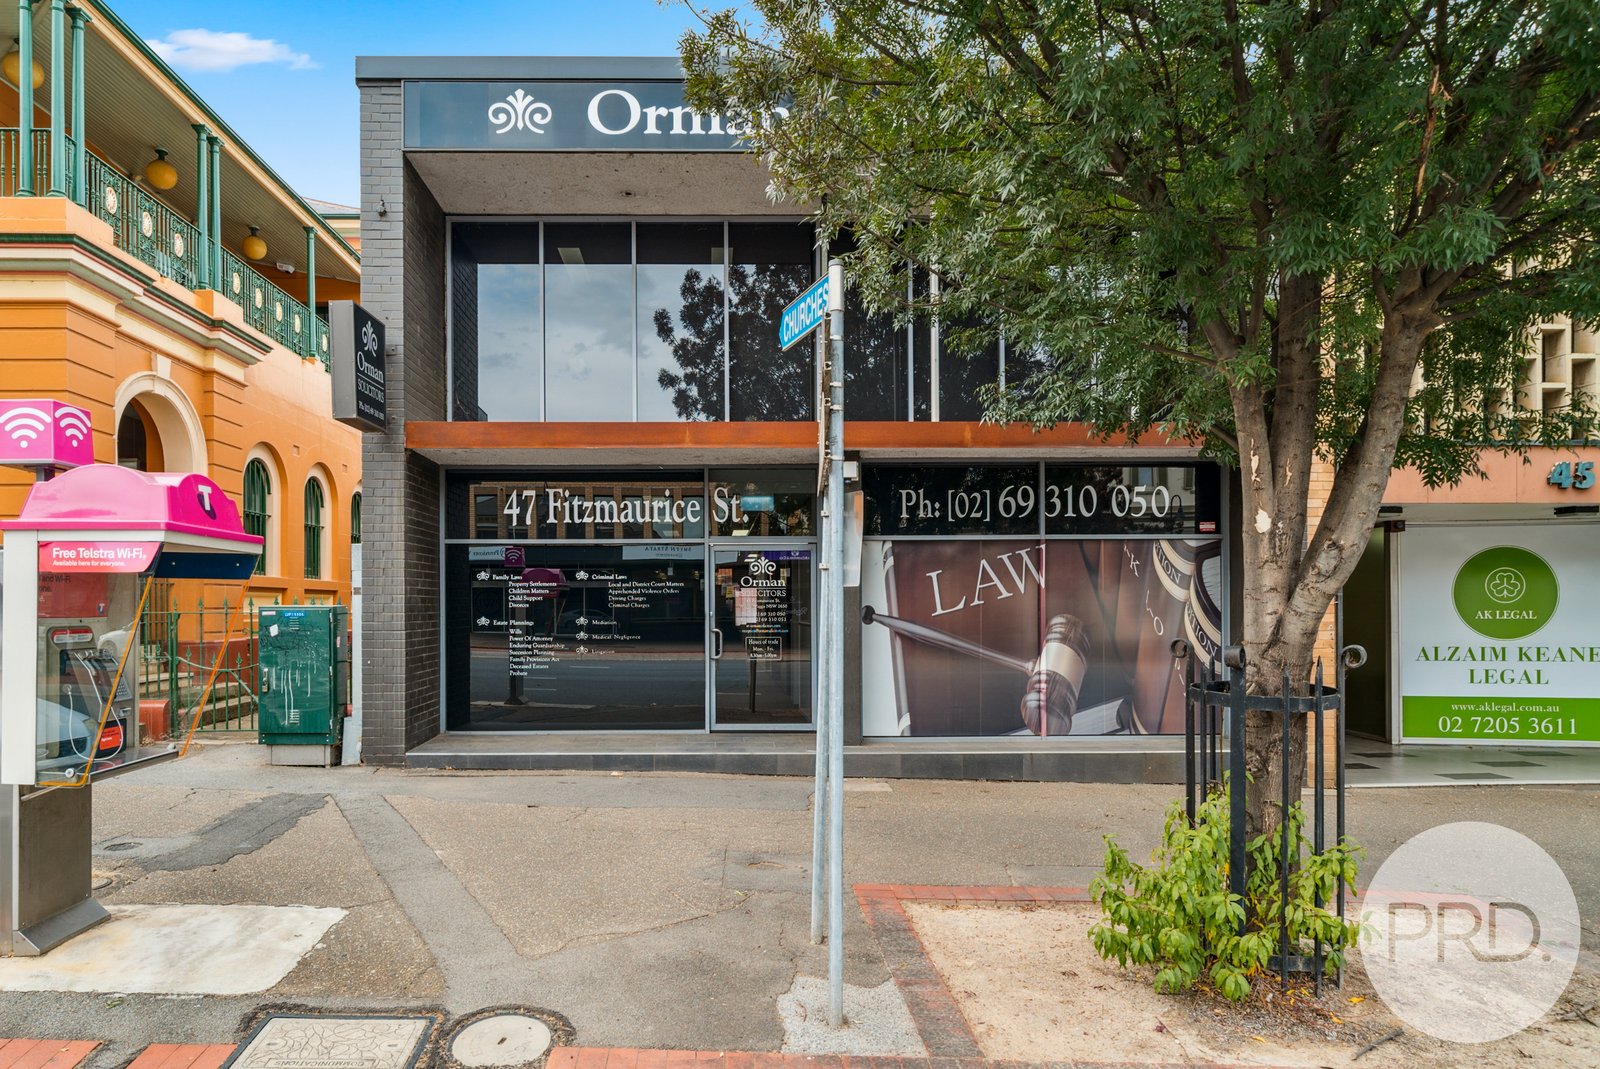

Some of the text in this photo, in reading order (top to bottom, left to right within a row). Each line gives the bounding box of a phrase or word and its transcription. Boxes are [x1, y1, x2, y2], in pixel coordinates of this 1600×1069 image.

[783, 282, 830, 342] CHURCHES
[357, 351, 384, 384] Orman
[357, 378, 384, 403] SOLICITORS
[1547, 461, 1596, 489] 45
[503, 487, 749, 526] 47 Fitzmaurice St.
[899, 485, 1170, 521] Ph: [02] 69 310 050
[52, 547, 76, 558] Free
[77, 547, 115, 559] Telstra
[741, 576, 786, 587] Orman
[926, 543, 1047, 617] LAW
[1475, 610, 1537, 620] AK LEGAL
[1416, 646, 1600, 663] ALZAIM KEANE
[1468, 668, 1549, 685] LEGAL
[1451, 702, 1560, 713] www.aklegal.com.au
[1438, 716, 1577, 735] 02 7205 3611
